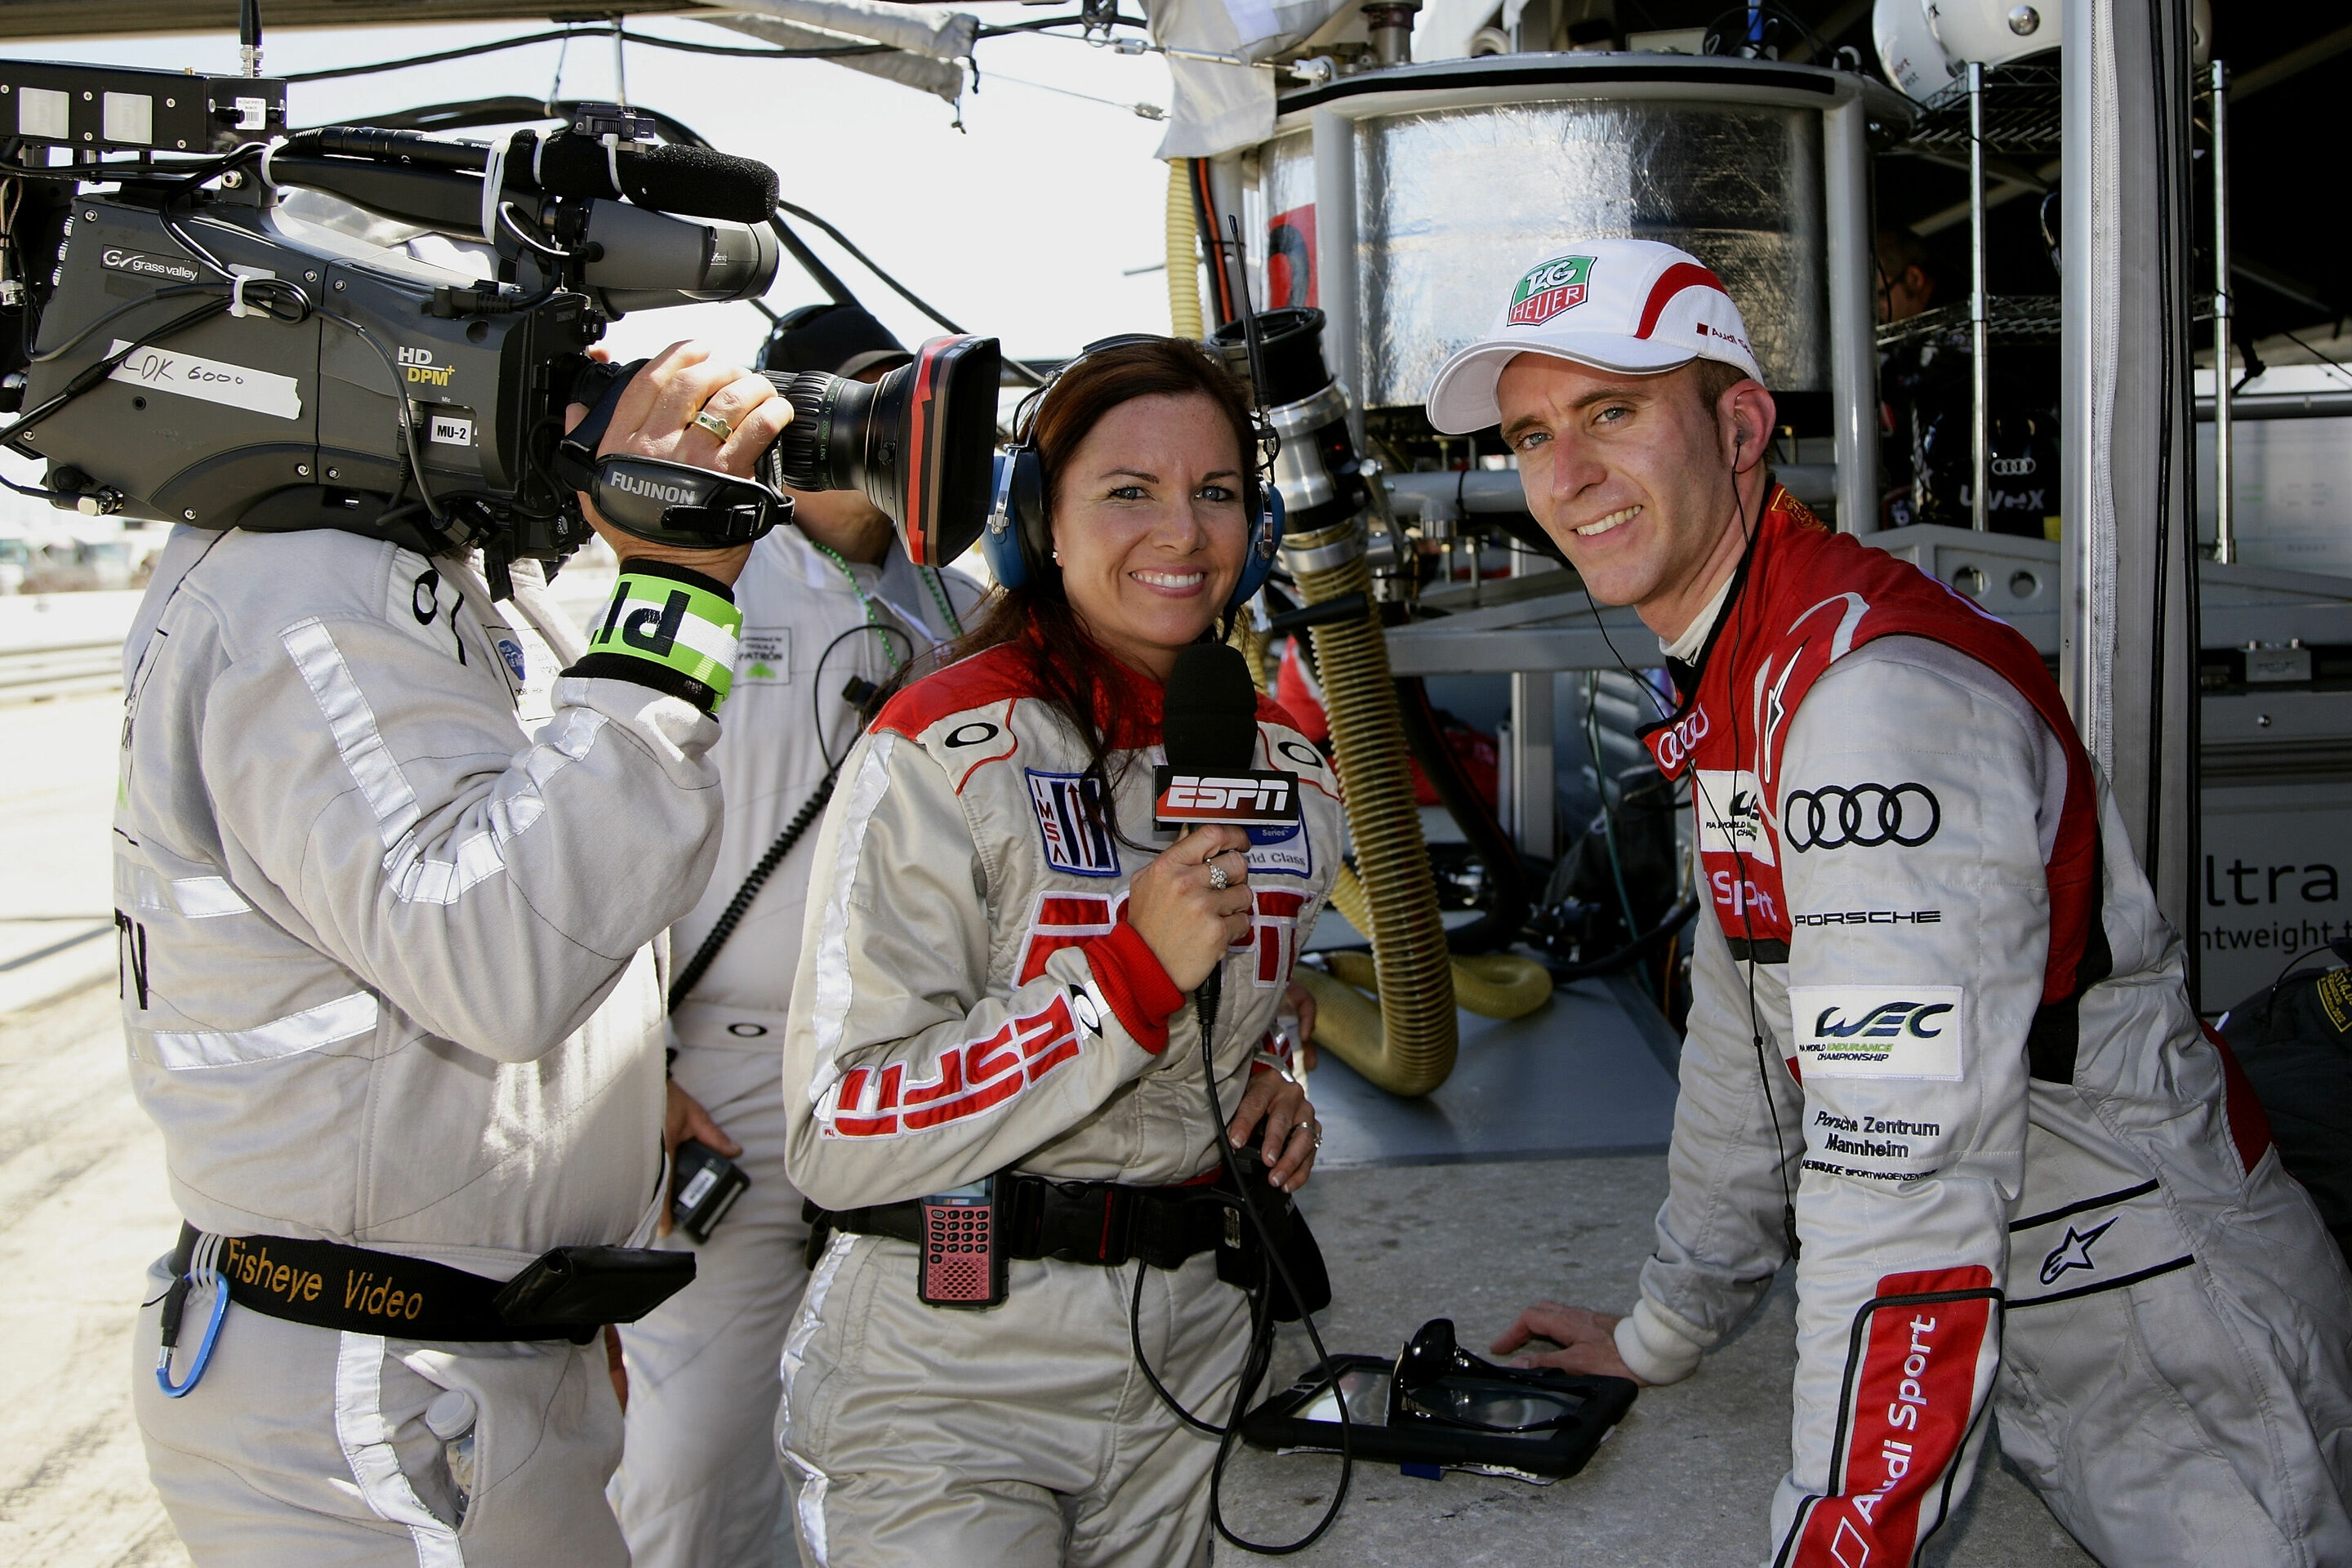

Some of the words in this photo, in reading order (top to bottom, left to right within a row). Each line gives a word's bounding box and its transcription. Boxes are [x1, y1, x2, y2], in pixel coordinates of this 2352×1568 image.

[132, 260, 165, 272] grass
[166, 266, 198, 281] valley
[1525, 259, 1579, 298] TAG
[1512, 287, 1580, 320] HEUER
[398, 345, 433, 366] HD
[436, 424, 467, 440] MU-2
[821, 420, 829, 440] ZOOM
[610, 470, 696, 506] FUJINON
[1166, 775, 1290, 811] ESPN
[1247, 852, 1267, 864] rld
[1271, 852, 1306, 866] Class
[2206, 855, 2339, 907] ltra
[1794, 910, 1941, 928] PORSCHE
[1815, 1001, 1954, 1039] WEC
[1817, 1053, 1890, 1062] CHAMPIONSHIP
[1827, 1043, 1895, 1053] ENDURANCE
[833, 989, 1082, 1137] ESPN
[1814, 1110, 1859, 1133] Porsche
[1863, 1116, 1940, 1137] Zentrum
[1824, 1132, 1909, 1158] Mannheim
[225, 1237, 323, 1303] Fisheye
[345, 1269, 424, 1321] Video
[1851, 1439, 1913, 1526] Audi
[1887, 1313, 1937, 1431] Sport
